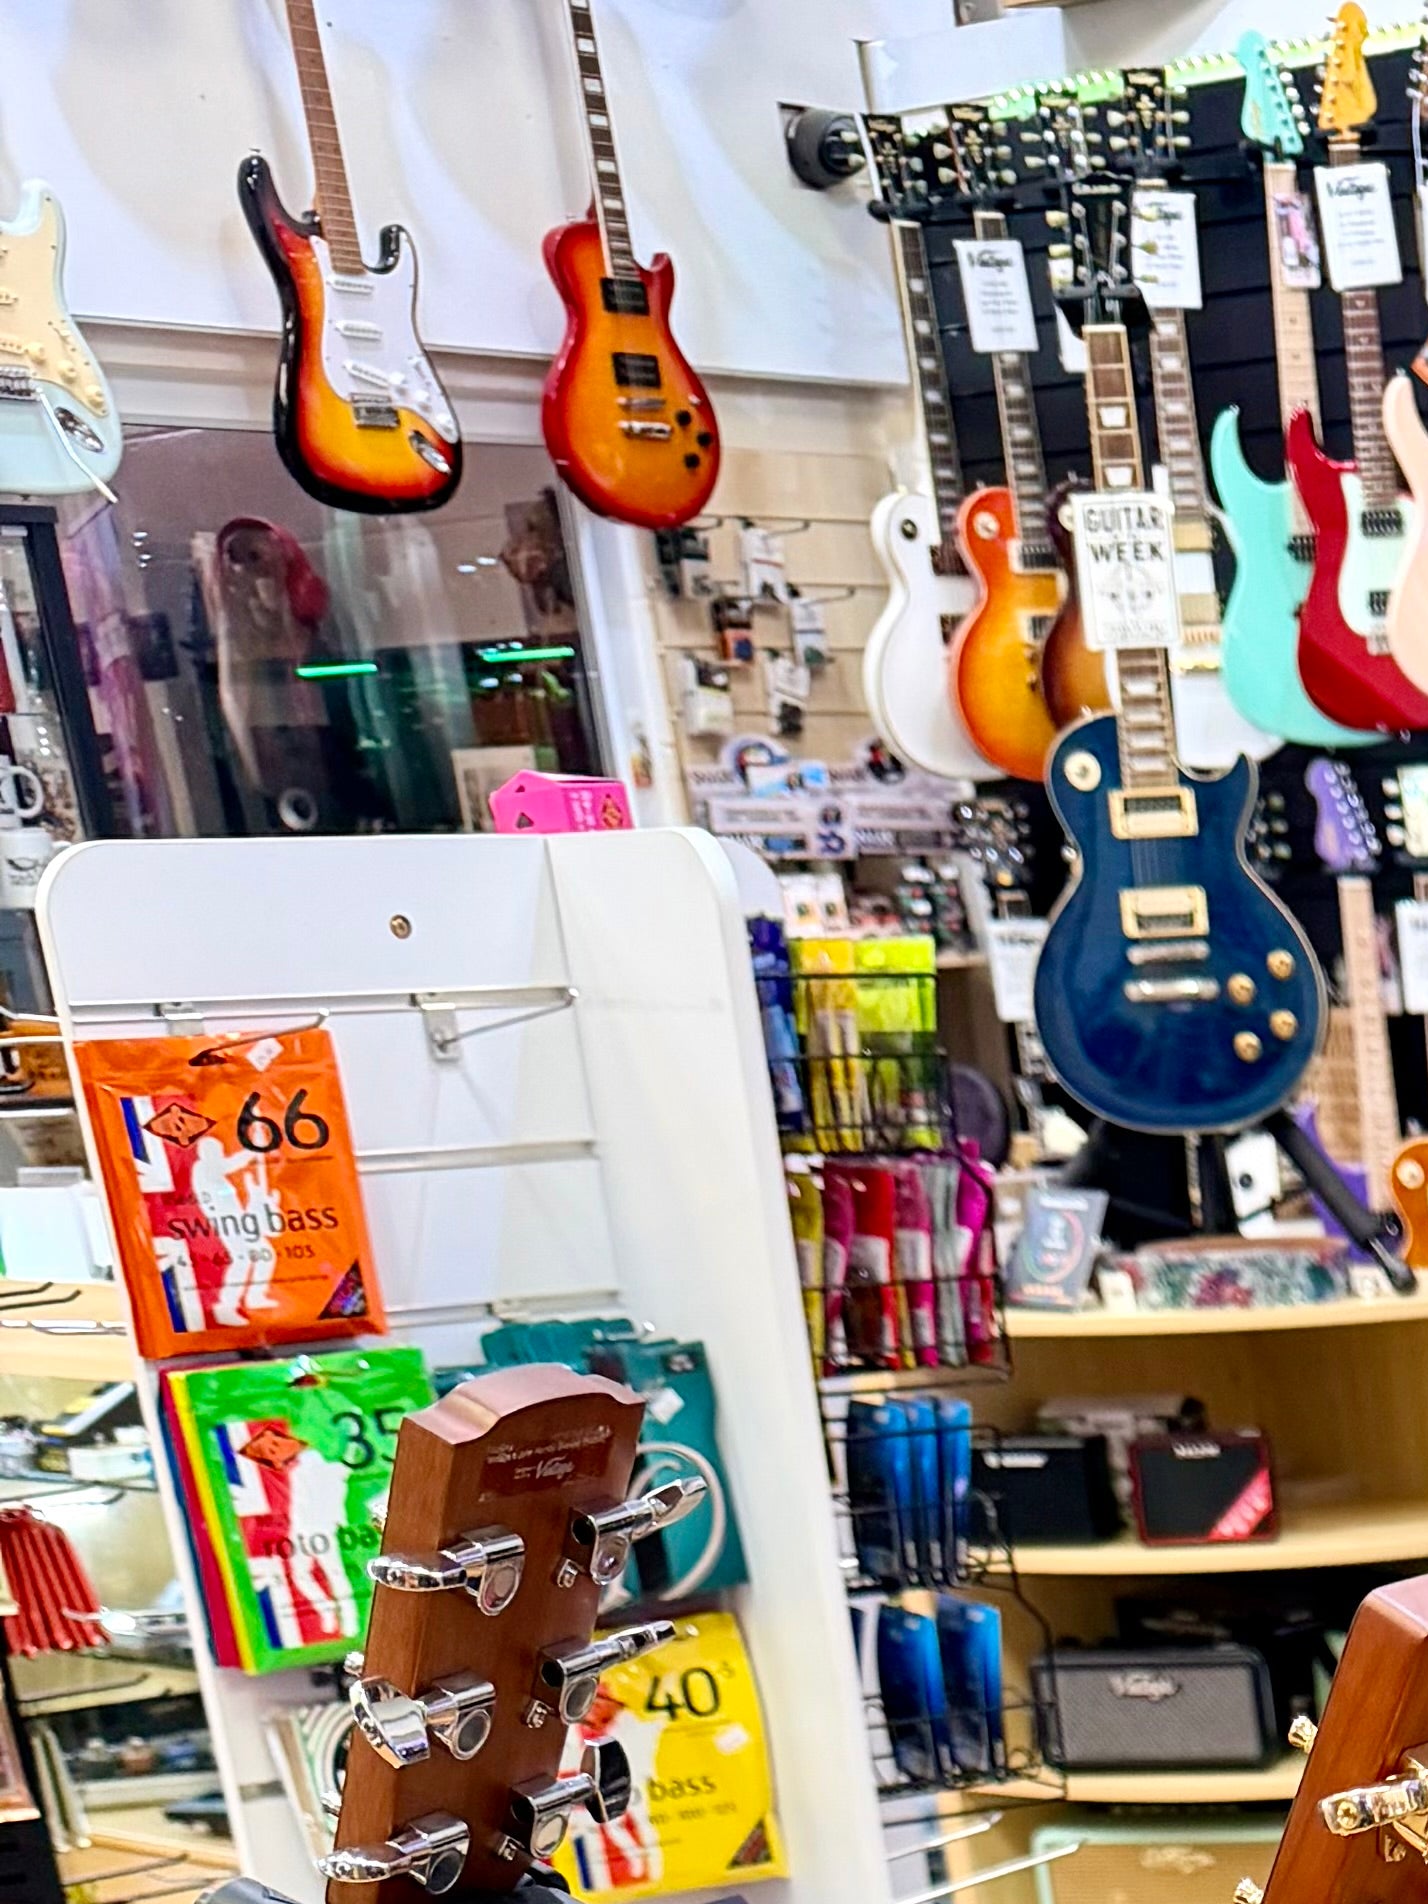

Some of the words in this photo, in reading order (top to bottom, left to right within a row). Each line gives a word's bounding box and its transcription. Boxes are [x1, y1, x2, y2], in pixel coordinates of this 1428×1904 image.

[1086, 506, 1165, 533] GUITAR
[1087, 541, 1164, 563] WEEK
[236, 1089, 330, 1153] 66
[167, 1206, 258, 1241] swing
[265, 1204, 339, 1233] bass
[263, 1533, 330, 1560] roto
[336, 1524, 379, 1551] ba
[649, 1776, 718, 1802] bass
